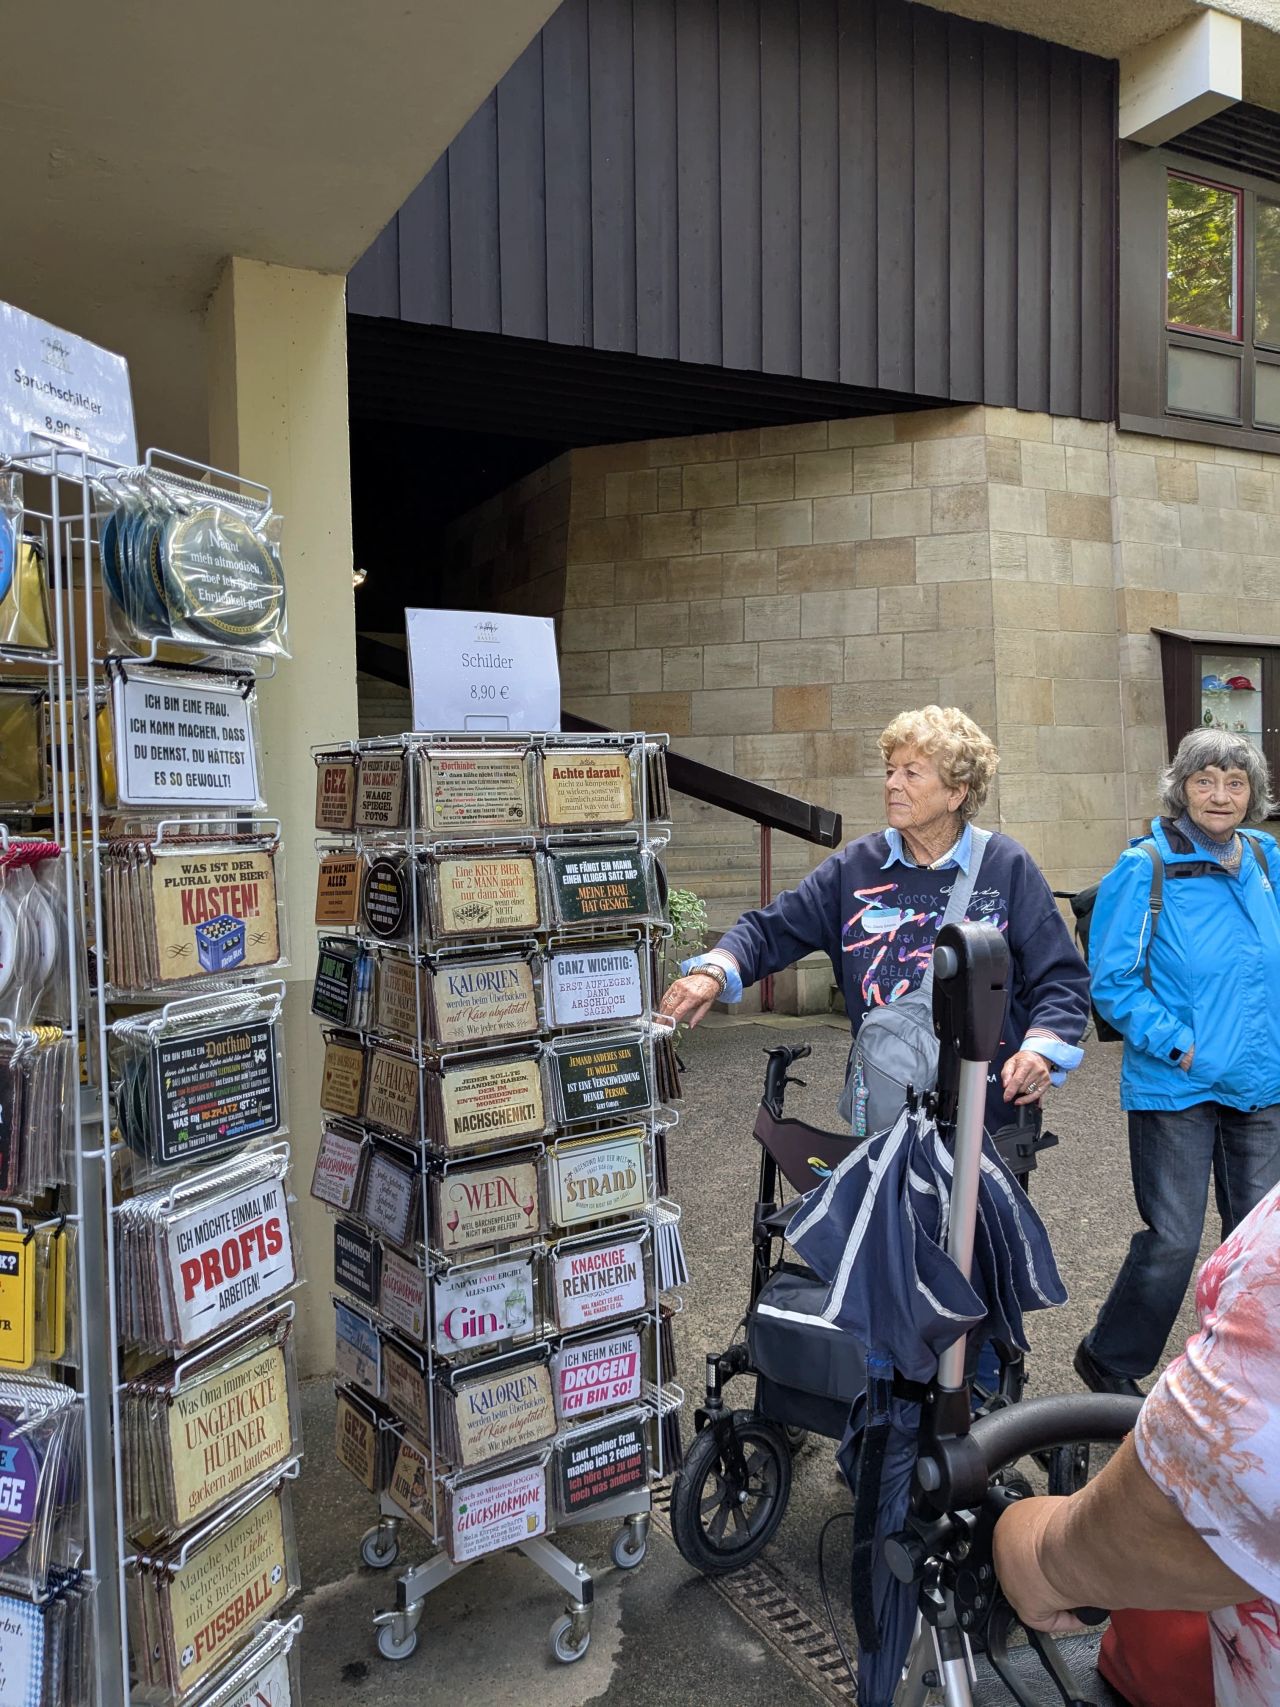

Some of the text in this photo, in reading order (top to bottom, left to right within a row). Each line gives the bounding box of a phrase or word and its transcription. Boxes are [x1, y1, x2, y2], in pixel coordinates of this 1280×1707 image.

[14, 368, 103, 415] Spruchschilder
[45, 416, 71, 436] 8,90
[208, 528, 240, 553] Nennt
[191, 551, 213, 566] mich
[201, 571, 219, 584] aber
[461, 653, 514, 669] Schilder
[470, 685, 510, 701] 8,90 €
[145, 693, 230, 717] ICH BIN EINE FRAU.
[130, 718, 245, 742] ICH KANN MACHEN, DASS
[134, 745, 245, 765] DU DENKST, DU HÄTTEST
[154, 771, 232, 788] ES SO GEWOLLT!
[324, 768, 347, 794] GEZ
[552, 766, 624, 780] Achte darauf,
[365, 790, 392, 801] WAAGE
[362, 801, 393, 812] SPIEGEL
[365, 811, 388, 822] FOTOS
[181, 860, 253, 875] WAS IST DER
[333, 864, 356, 874] MACHEN
[455, 864, 520, 877] Eine KISTE BIER
[565, 860, 632, 874] WIE FÄNGT EIN MANN
[164, 871, 270, 888] PLURAL VON BIER?
[327, 875, 347, 888] ALLES
[466, 876, 499, 888] 2 MANN
[562, 869, 638, 885] EINEN KLUGEN SATZ AN?
[461, 889, 498, 901] nur dann
[606, 883, 629, 897] FRAU
[180, 883, 260, 926] KASTEN!
[581, 899, 598, 913] HAT
[897, 893, 938, 907] SOCCX
[557, 956, 633, 975] GANZ WICHTIG:
[447, 969, 520, 998] KALORIEN
[560, 977, 635, 992] ERST AUFLEGEN,
[587, 988, 610, 998] DANN
[447, 996, 488, 1009] werden beim
[572, 995, 626, 1009] ARSCHLOCH
[584, 1005, 616, 1016] SAGEN!
[446, 1001, 530, 1023] mit Käse abgetötet!
[466, 1022, 496, 1035] Wie jeder
[162, 1032, 252, 1063] ICH Dorfkind
[568, 1056, 592, 1067] JEMAND
[374, 1058, 417, 1097] ZUHAUSE
[461, 1070, 521, 1085] JEDER SOLLTE
[454, 1081, 498, 1092] JEMANDEN
[478, 1087, 496, 1095] DER
[567, 1080, 592, 1093] IST EINE
[456, 1087, 529, 1105] ENTSCHEIDENDEN
[476, 1096, 512, 1108] MOMENT
[582, 1090, 605, 1103] DEINER
[453, 1103, 536, 1134] NACHSCHENKT!
[449, 1175, 523, 1212] WEIN
[566, 1168, 637, 1203] STRAND
[176, 1189, 279, 1255] ICH MÖCHTE EINMAL MIT
[461, 1222, 474, 1231] WEIL
[465, 1225, 497, 1238] NICHT MEHR
[180, 1217, 283, 1303] PROFIS
[571, 1248, 627, 1275] KNACKIGE
[498, 1268, 523, 1279] ERGIBT
[562, 1262, 637, 1298] RENTNERIN
[218, 1271, 261, 1312] ARBEITEN!
[465, 1282, 506, 1297] ALLES EINEN
[443, 1306, 504, 1344] Gin.
[564, 1340, 633, 1368] ICH NEHM KEINE
[564, 1356, 630, 1392] DROGEN
[177, 1356, 278, 1419] Was Oma immer sagte:
[469, 1374, 538, 1415] KALORIEN
[562, 1380, 632, 1411] ICH BIN SO!
[184, 1375, 277, 1450] UNGEFICKTE
[466, 1413, 492, 1429] werden
[203, 1415, 267, 1475] HÜHNER
[487, 1440, 501, 1452] Wie
[571, 1431, 635, 1463] Laut meiner Frau
[567, 1442, 642, 1479] mache 2 Fehler:
[188, 1433, 284, 1513] gackern am lautesten!
[583, 1454, 641, 1486] höre nie zu und
[570, 1480, 608, 1504] noch was
[457, 1487, 540, 1533] GLÜCKSHORMONE
[469, 1496, 494, 1508] erzeugt
[179, 1508, 274, 1593] Manche Menschen
[188, 1531, 268, 1605] schreiben Liebe
[185, 1598, 213, 1629] mit 8
[193, 1571, 273, 1664] FUSSBALL
